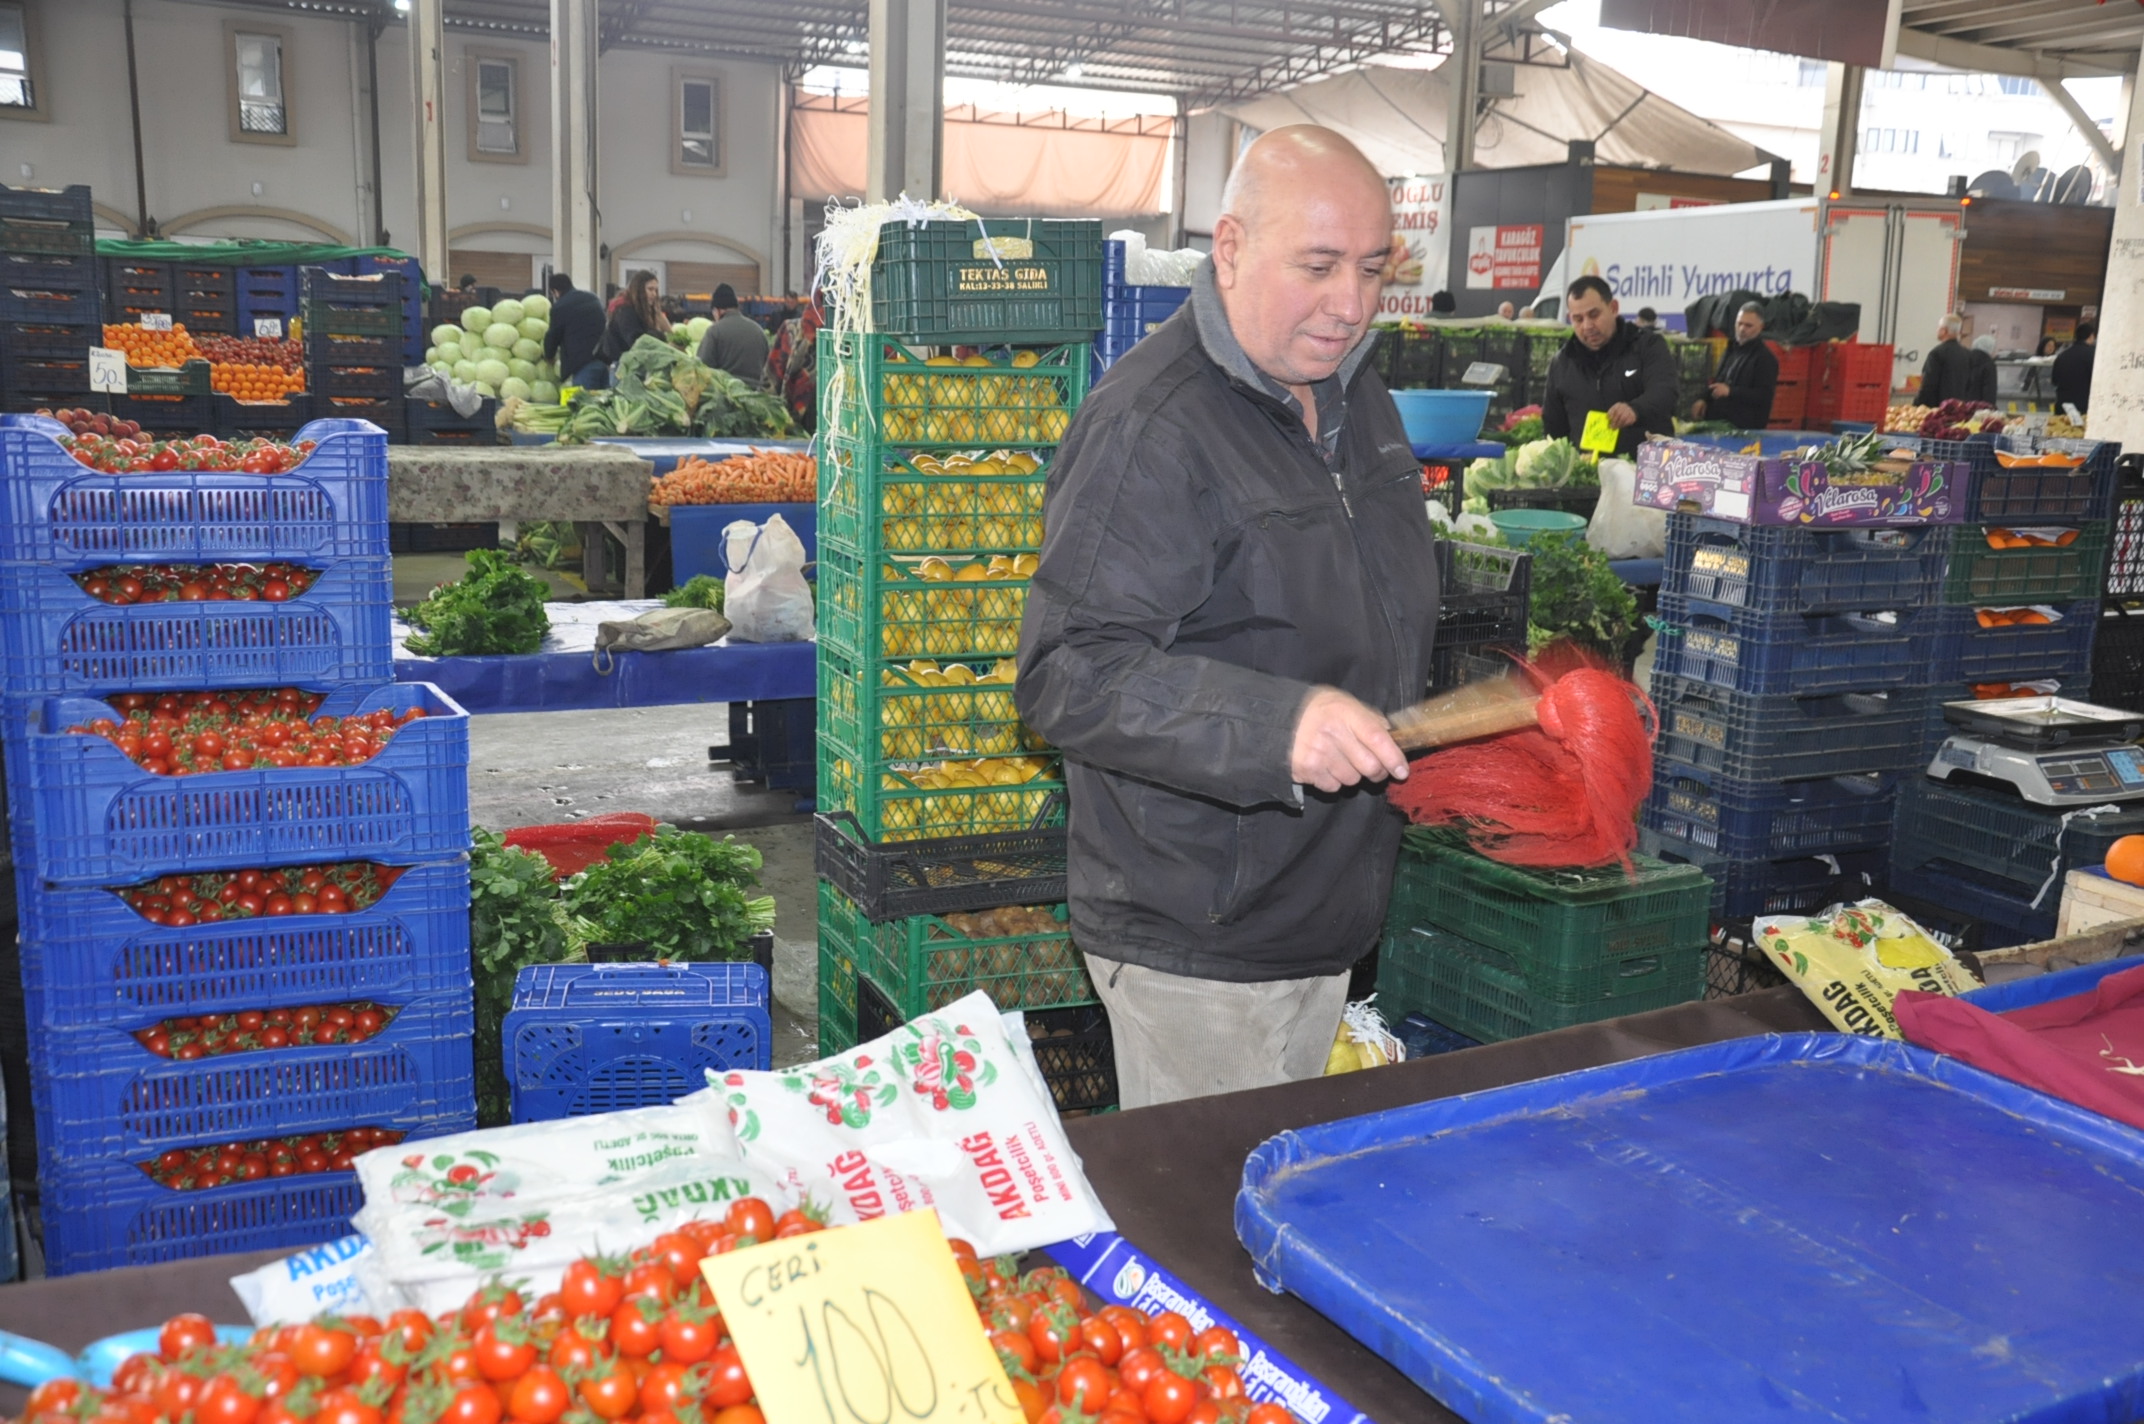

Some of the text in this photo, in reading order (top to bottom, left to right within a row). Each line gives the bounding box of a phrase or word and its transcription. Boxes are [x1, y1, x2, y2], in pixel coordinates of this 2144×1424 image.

[1606, 264, 1793, 299] Salihli Yumurta
[827, 1150, 886, 1221] KDAĞ
[1005, 1134, 1049, 1203] Poşetcilik
[741, 1242, 822, 1316] ÇERİ
[795, 1287, 937, 1424] 100
